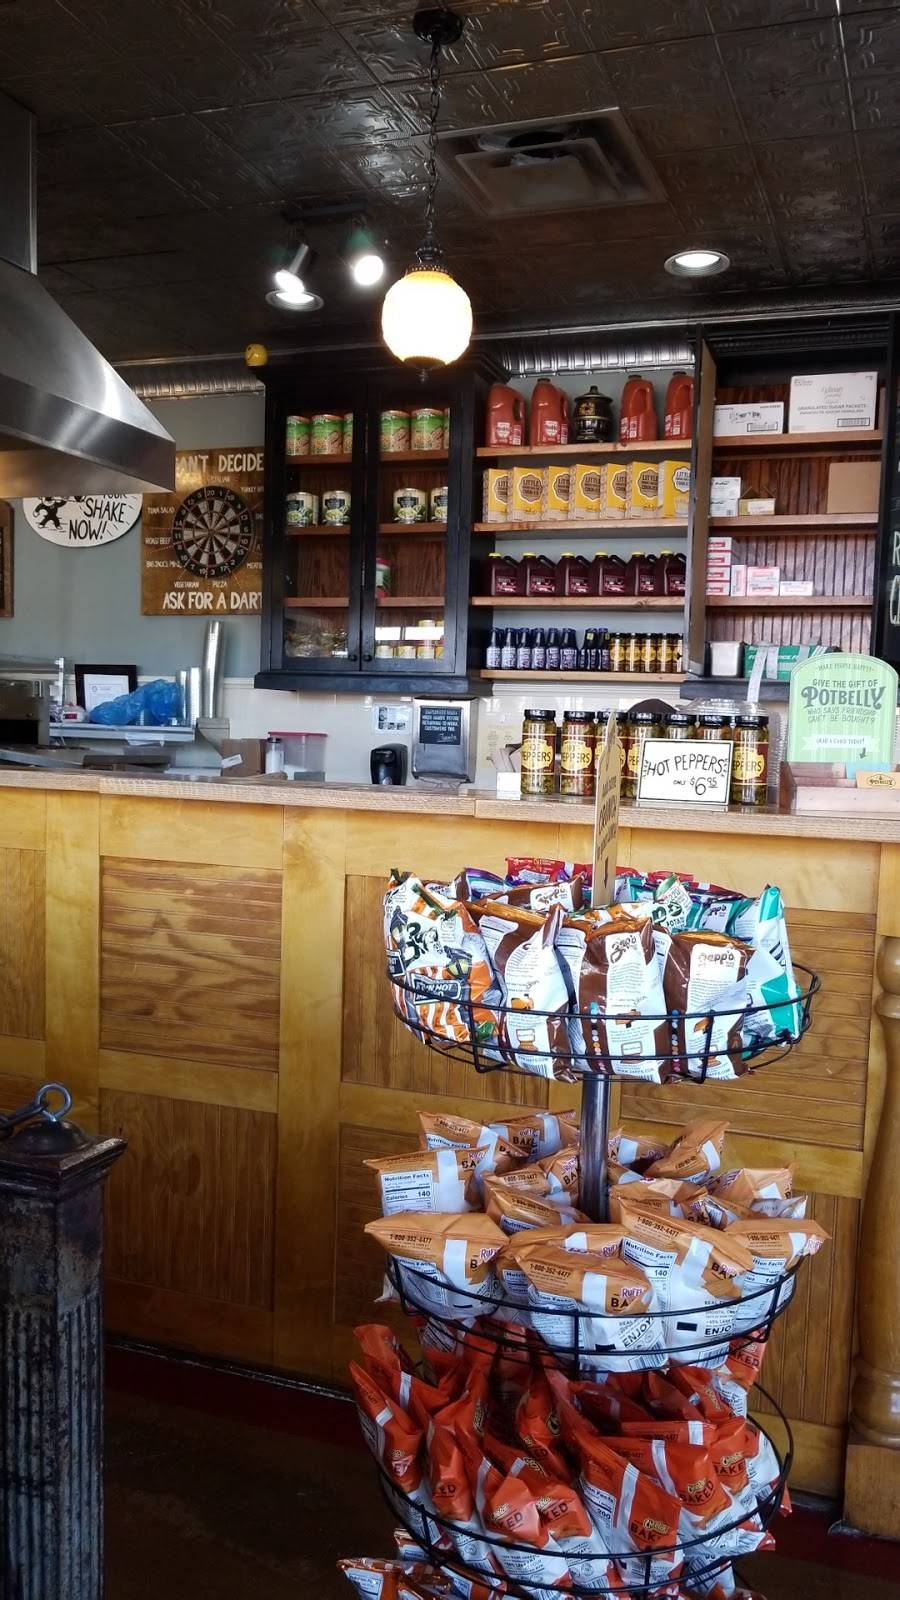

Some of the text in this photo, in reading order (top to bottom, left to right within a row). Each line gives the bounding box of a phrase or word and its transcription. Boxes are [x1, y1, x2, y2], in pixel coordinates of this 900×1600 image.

[218, 452, 264, 472] DECIDE
[84, 498, 126, 523] SHAKE
[68, 520, 108, 540] NOW!
[162, 592, 263, 610] ASK FOR A DART
[813, 679, 830, 687] GIVE
[848, 680, 865, 688] GIFT
[801, 686, 886, 710] POTBELLY
[647, 753, 724, 776] HOT PEPPERS
[436, 984, 452, 992] HOT
[638, 1216, 679, 1237] 1-800-352-4477
[390, 1234, 432, 1244] 1-800-352-4477
[626, 1241, 654, 1257] Nutrition
[530, 1263, 571, 1278] 1-800-352-4477
